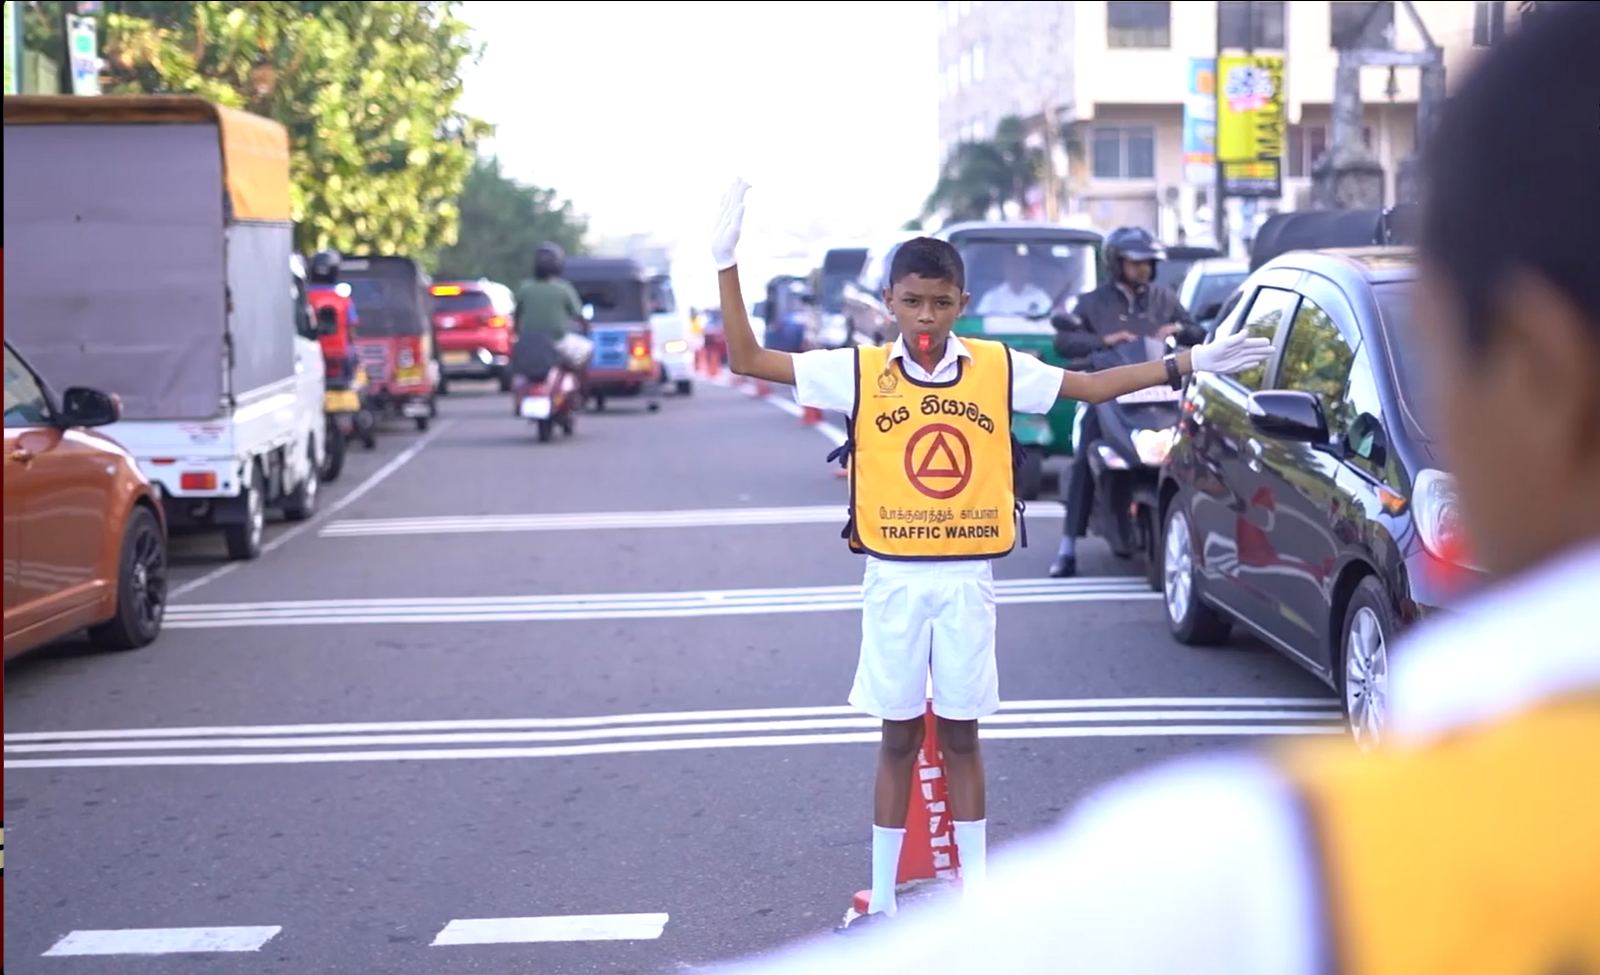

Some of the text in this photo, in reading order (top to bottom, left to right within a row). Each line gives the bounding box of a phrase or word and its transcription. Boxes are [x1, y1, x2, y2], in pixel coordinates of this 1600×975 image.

[875, 394, 994, 434] රිය නියාමක
[881, 525, 999, 539] TRAFFIC WARDEN
